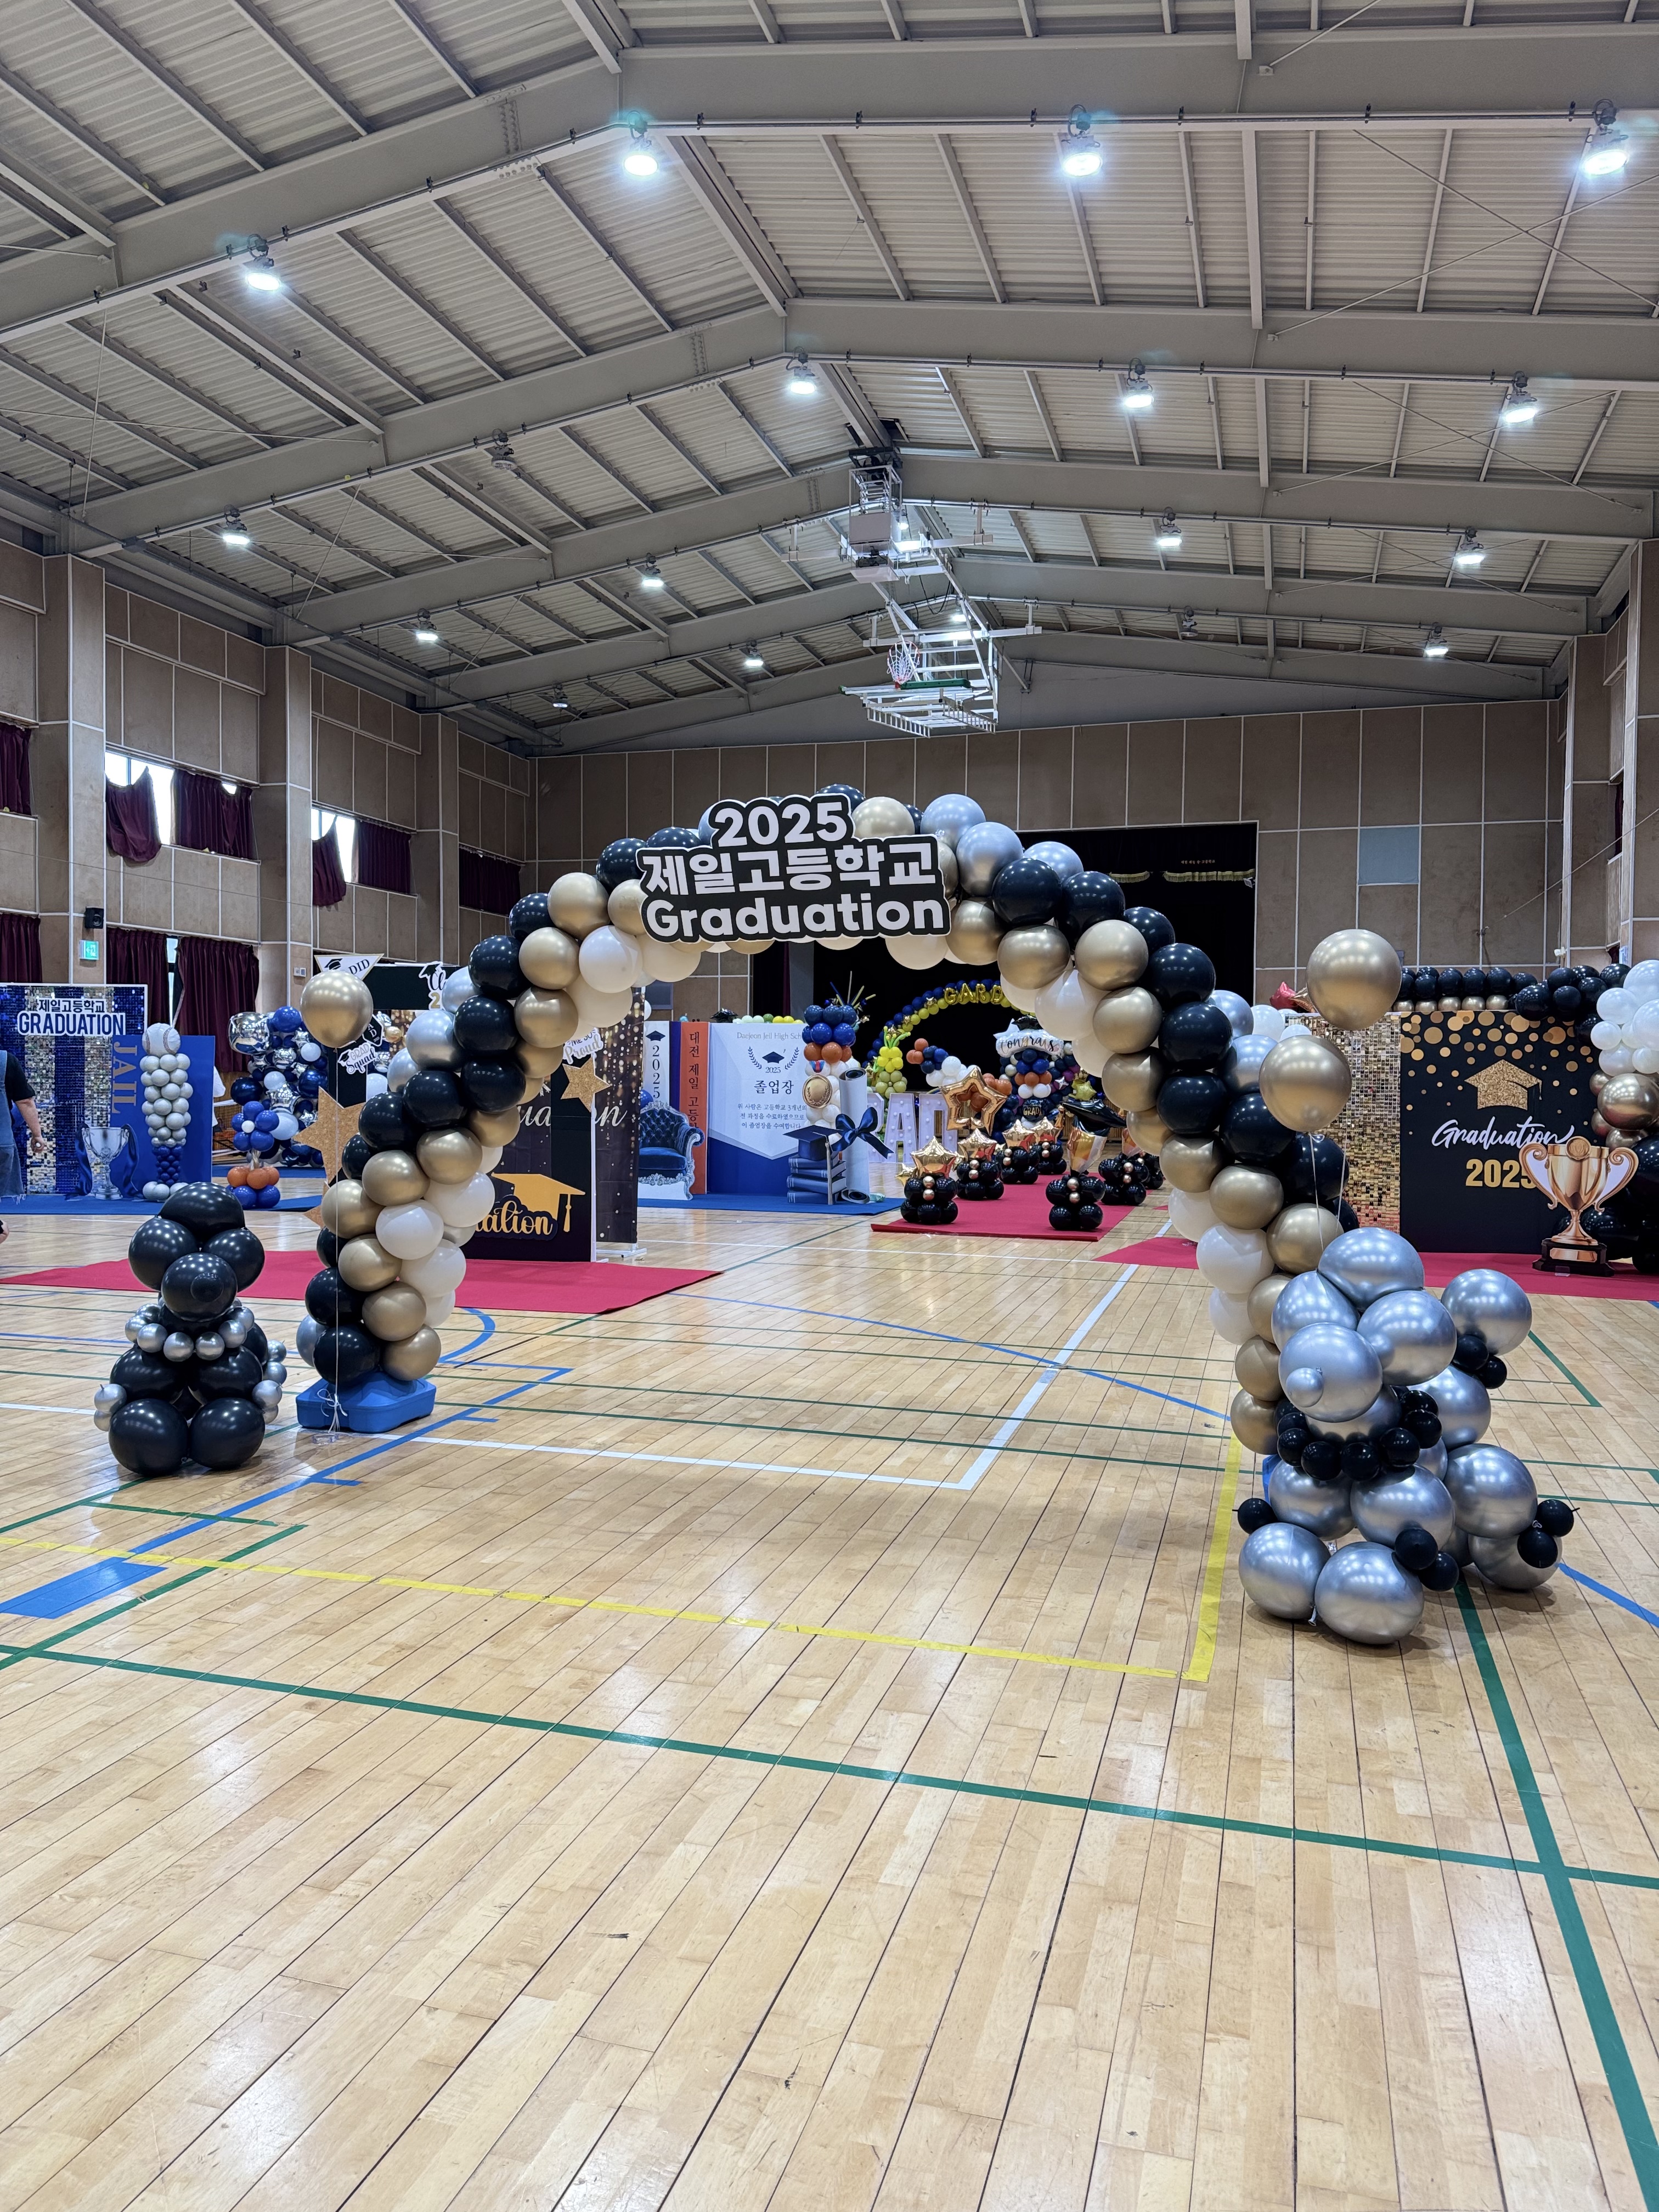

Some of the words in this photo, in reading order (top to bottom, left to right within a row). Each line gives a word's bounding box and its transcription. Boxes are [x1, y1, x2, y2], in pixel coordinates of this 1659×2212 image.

[714, 802, 847, 847] 2025
[642, 843, 936, 895] 제일고등학교
[646, 893, 944, 937] Graduation
[348, 959, 370, 975] DID
[38, 1000, 105, 1013] 제일고등학교
[19, 1013, 123, 1035] GRADUATION
[737, 1032, 761, 1040] Daejeon
[775, 1032, 788, 1041] High
[350, 1043, 370, 1061] GRAD
[565, 1034, 602, 1063] Proud
[689, 1031, 699, 1058] 대전
[346, 1047, 377, 1073] Squad
[112, 1041, 137, 1114] JAIL
[689, 1063, 699, 1090] 제일
[754, 1080, 794, 1094] 졸업장
[688, 1097, 699, 1128] 고등
[1431, 1116, 1575, 1150] Graduation
[475, 1200, 553, 1235] ation
